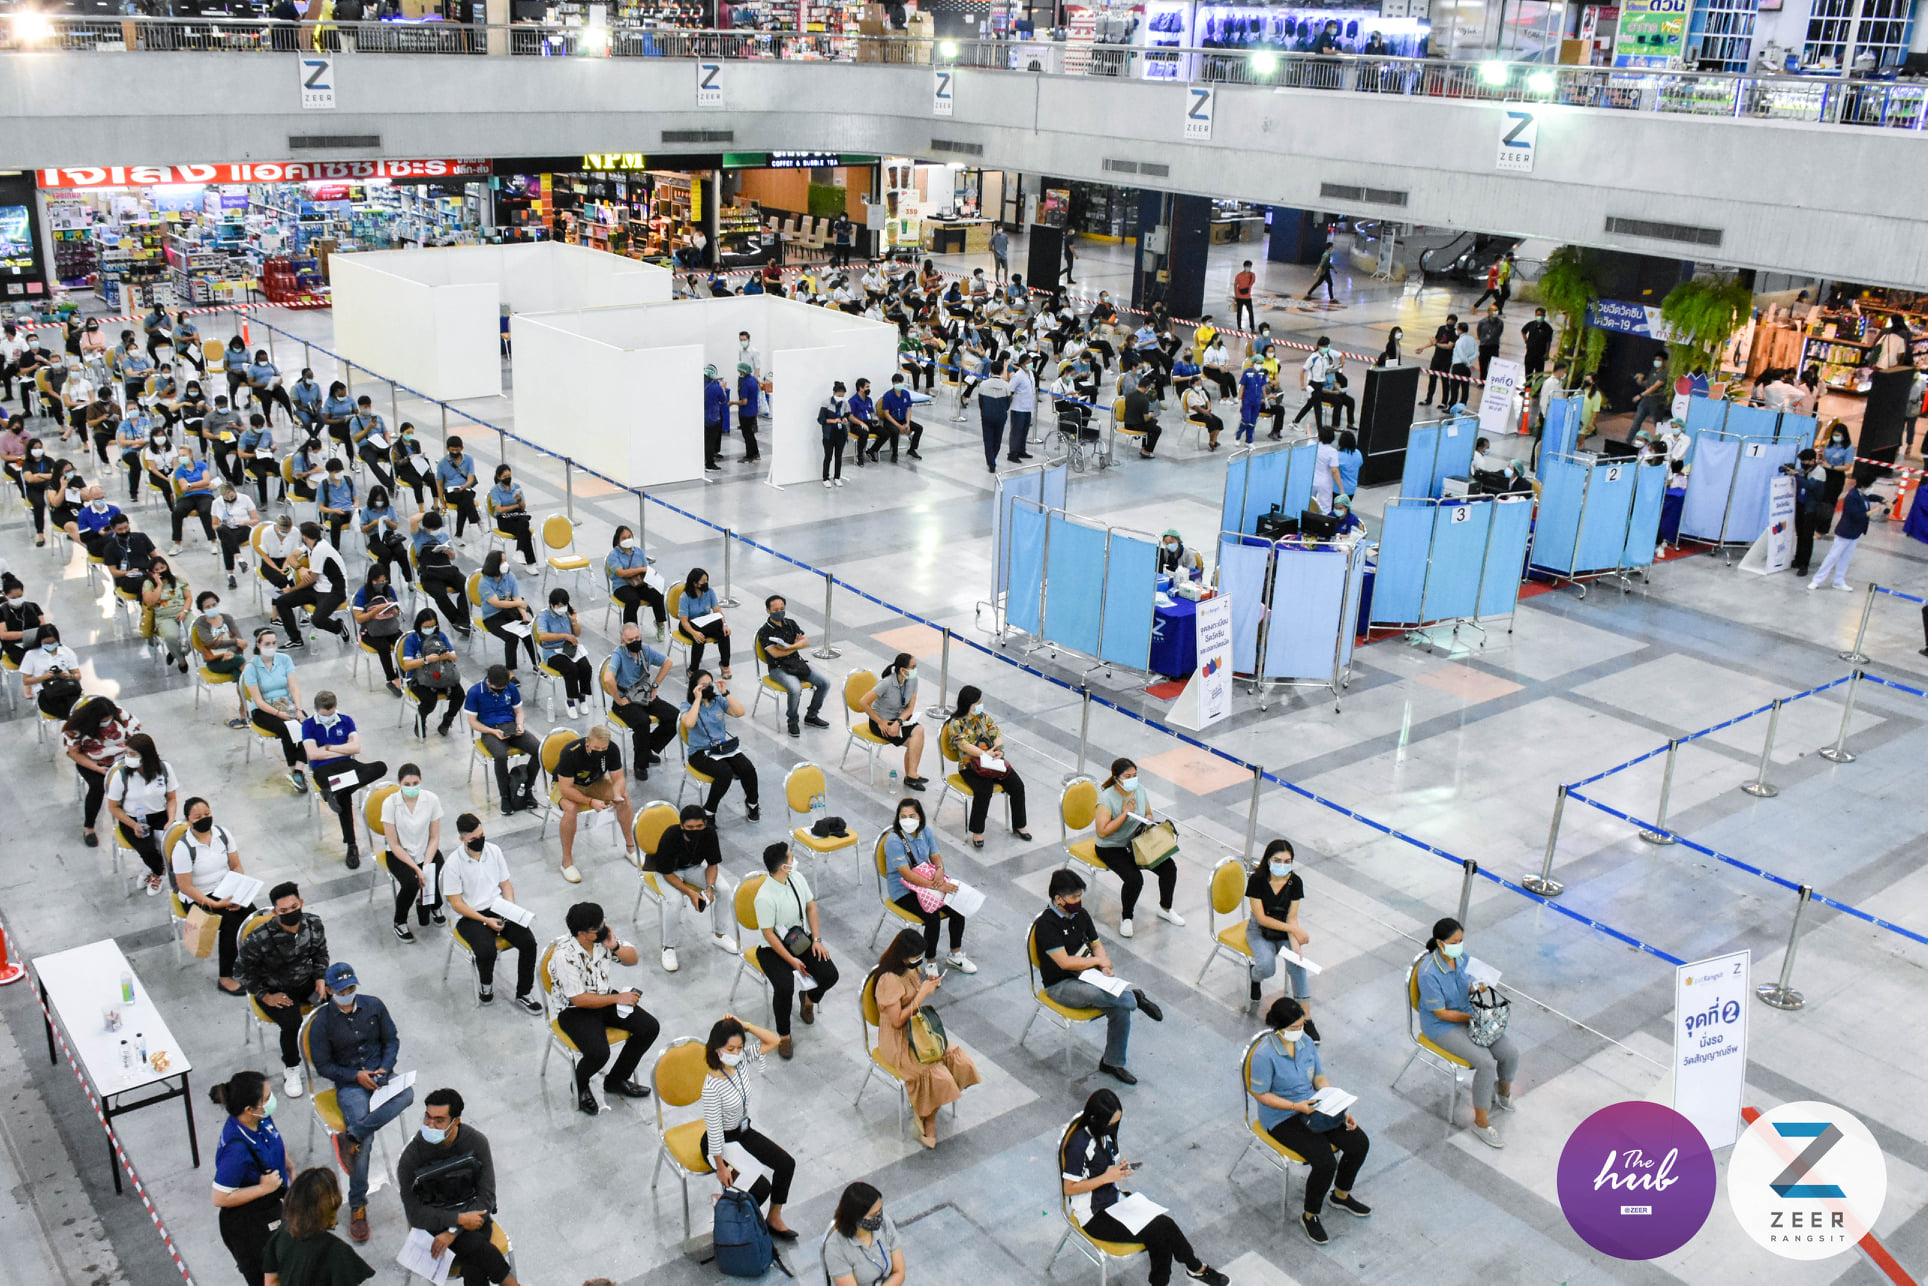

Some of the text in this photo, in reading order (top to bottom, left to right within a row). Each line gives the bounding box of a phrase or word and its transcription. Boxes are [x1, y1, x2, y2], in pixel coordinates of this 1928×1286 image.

[305, 94, 332, 102] ZEER
[582, 152, 645, 169] NPM
[826, 159, 839, 167] TEA
[1499, 152, 1530, 163] ZEER
[1752, 444, 1759, 457] 1
[1608, 467, 1618, 481] 2
[1456, 507, 1466, 521] 3
[1685, 996, 1739, 1038] จุดที่ 2
[1699, 1032, 1724, 1048] นั่งรอ
[1683, 1045, 1739, 1067] วัดสัญญาณชีพ
